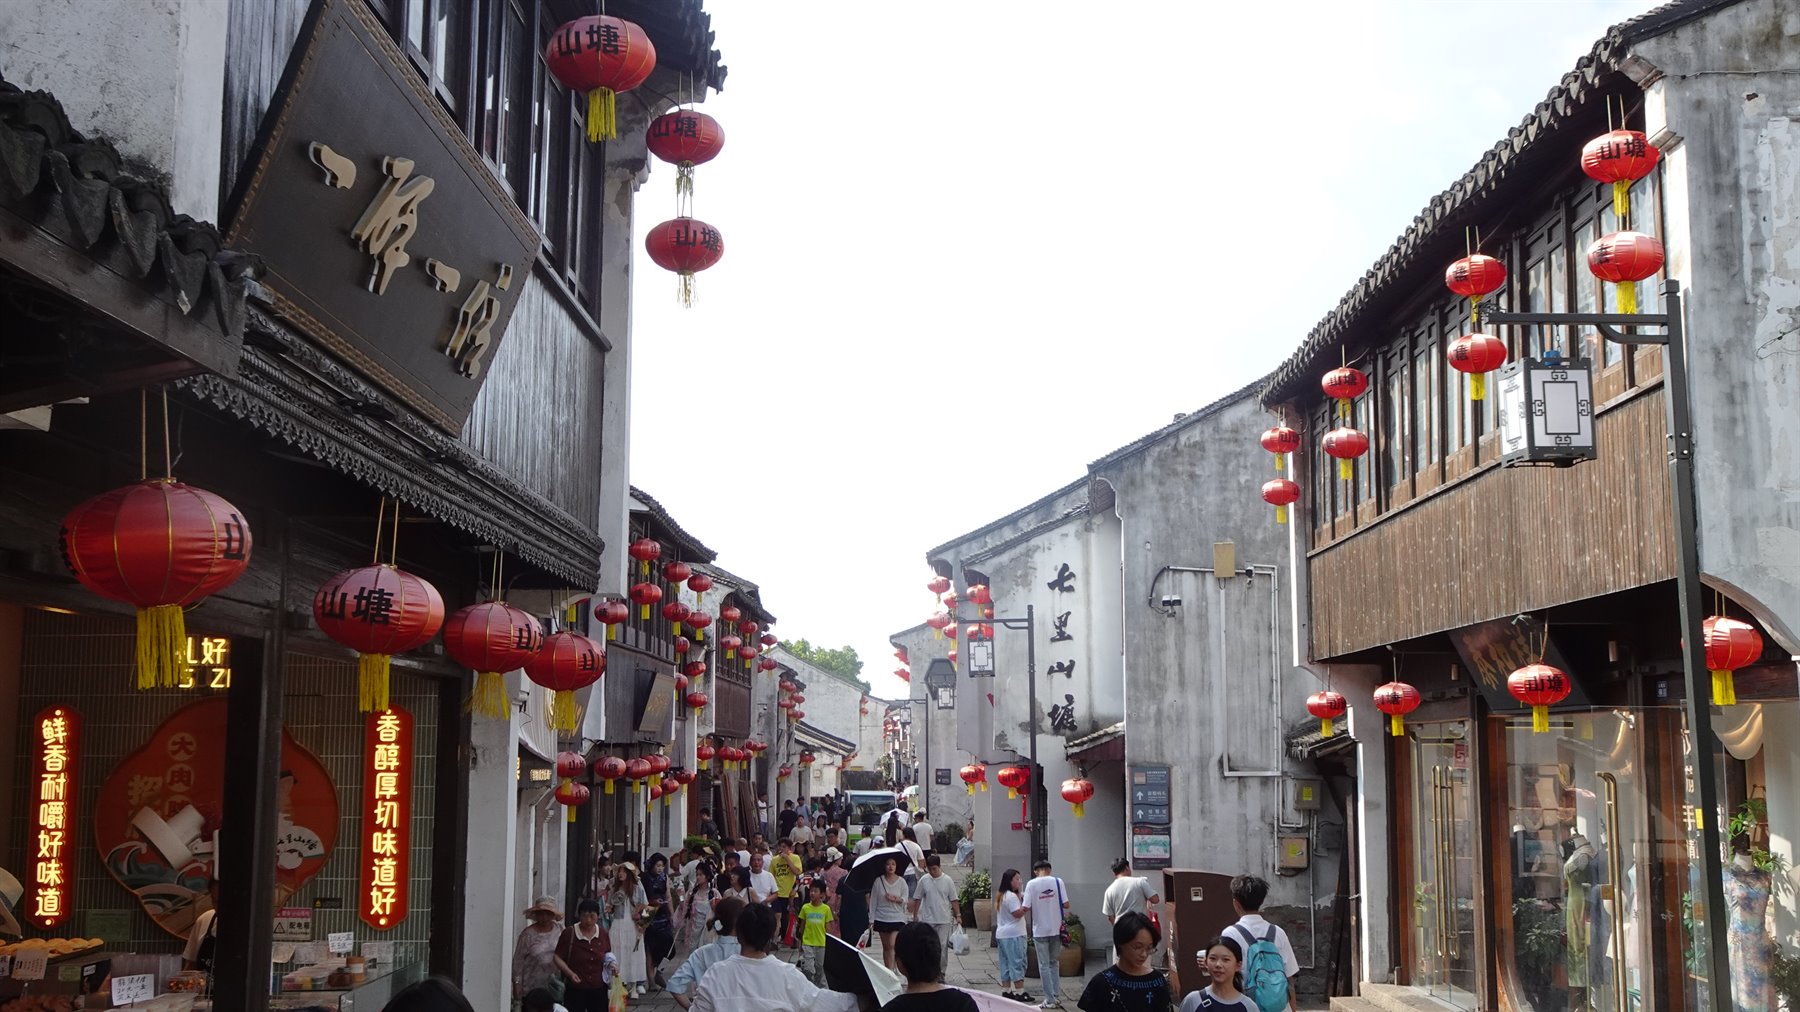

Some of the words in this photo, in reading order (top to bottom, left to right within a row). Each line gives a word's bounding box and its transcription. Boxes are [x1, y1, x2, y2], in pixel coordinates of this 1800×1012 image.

[557, 24, 620, 56] 山塘
[653, 116, 698, 139] 山塘
[1601, 137, 1647, 160] 山塘
[676, 225, 720, 251] 山塘
[1328, 374, 1357, 386] 山塘
[321, 587, 394, 626] 山塘
[1047, 562, 1078, 732] 七里山塘
[1525, 674, 1564, 693] 山塘
[35, 716, 68, 917] 鲜香耐嚼好味道
[371, 713, 402, 916] 香醇厚切味道好
